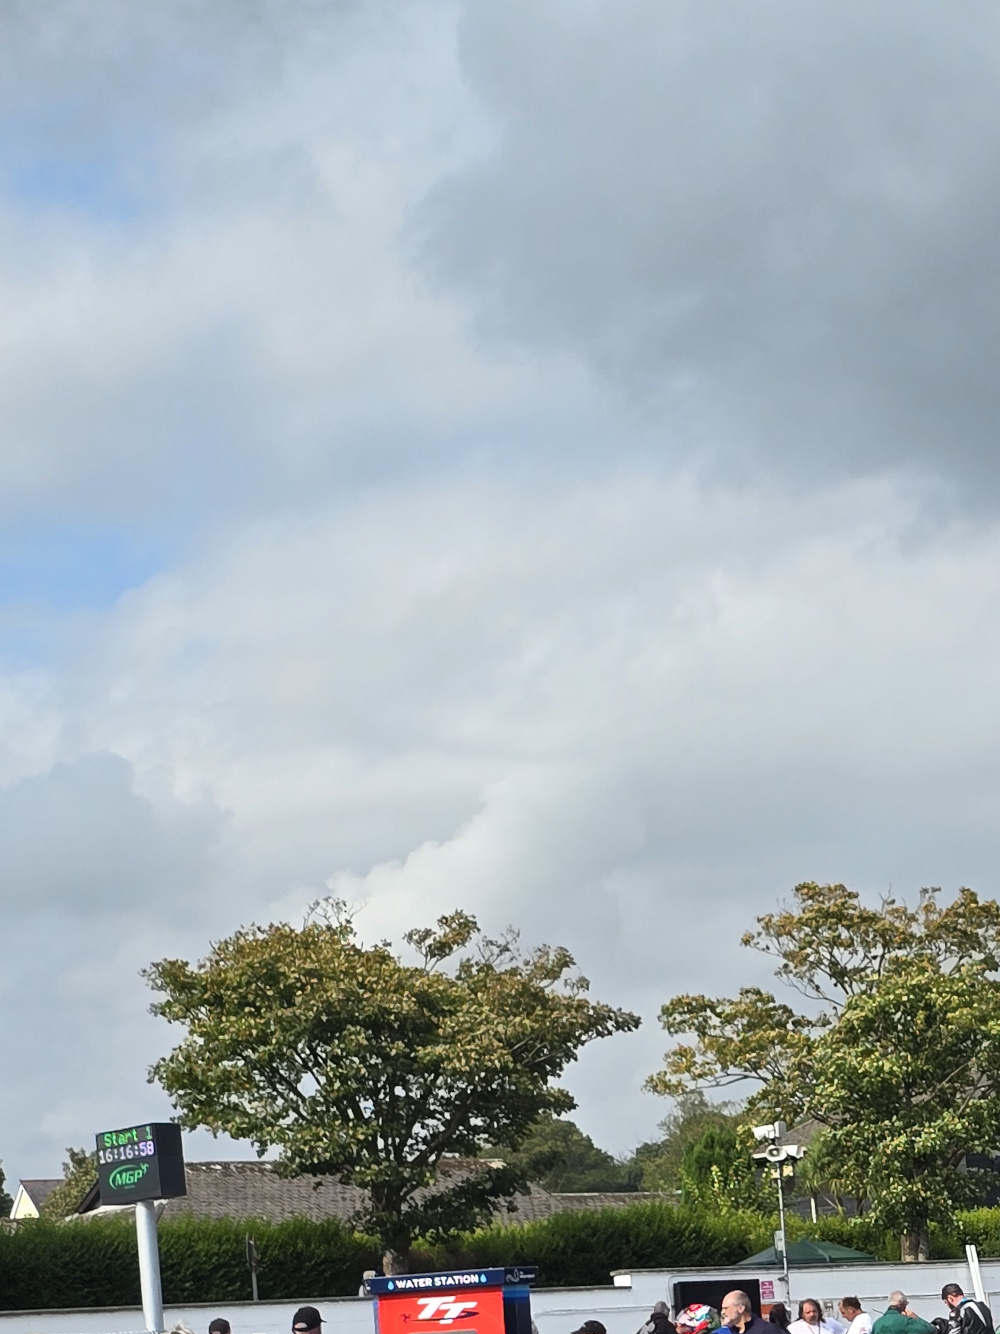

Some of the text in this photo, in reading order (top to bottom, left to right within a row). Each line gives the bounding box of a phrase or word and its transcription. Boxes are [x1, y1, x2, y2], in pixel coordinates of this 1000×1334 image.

[103, 1125, 153, 1147] Start 1
[115, 1169, 143, 1187] MGP
[395, 1274, 479, 1289] WATER STATION
